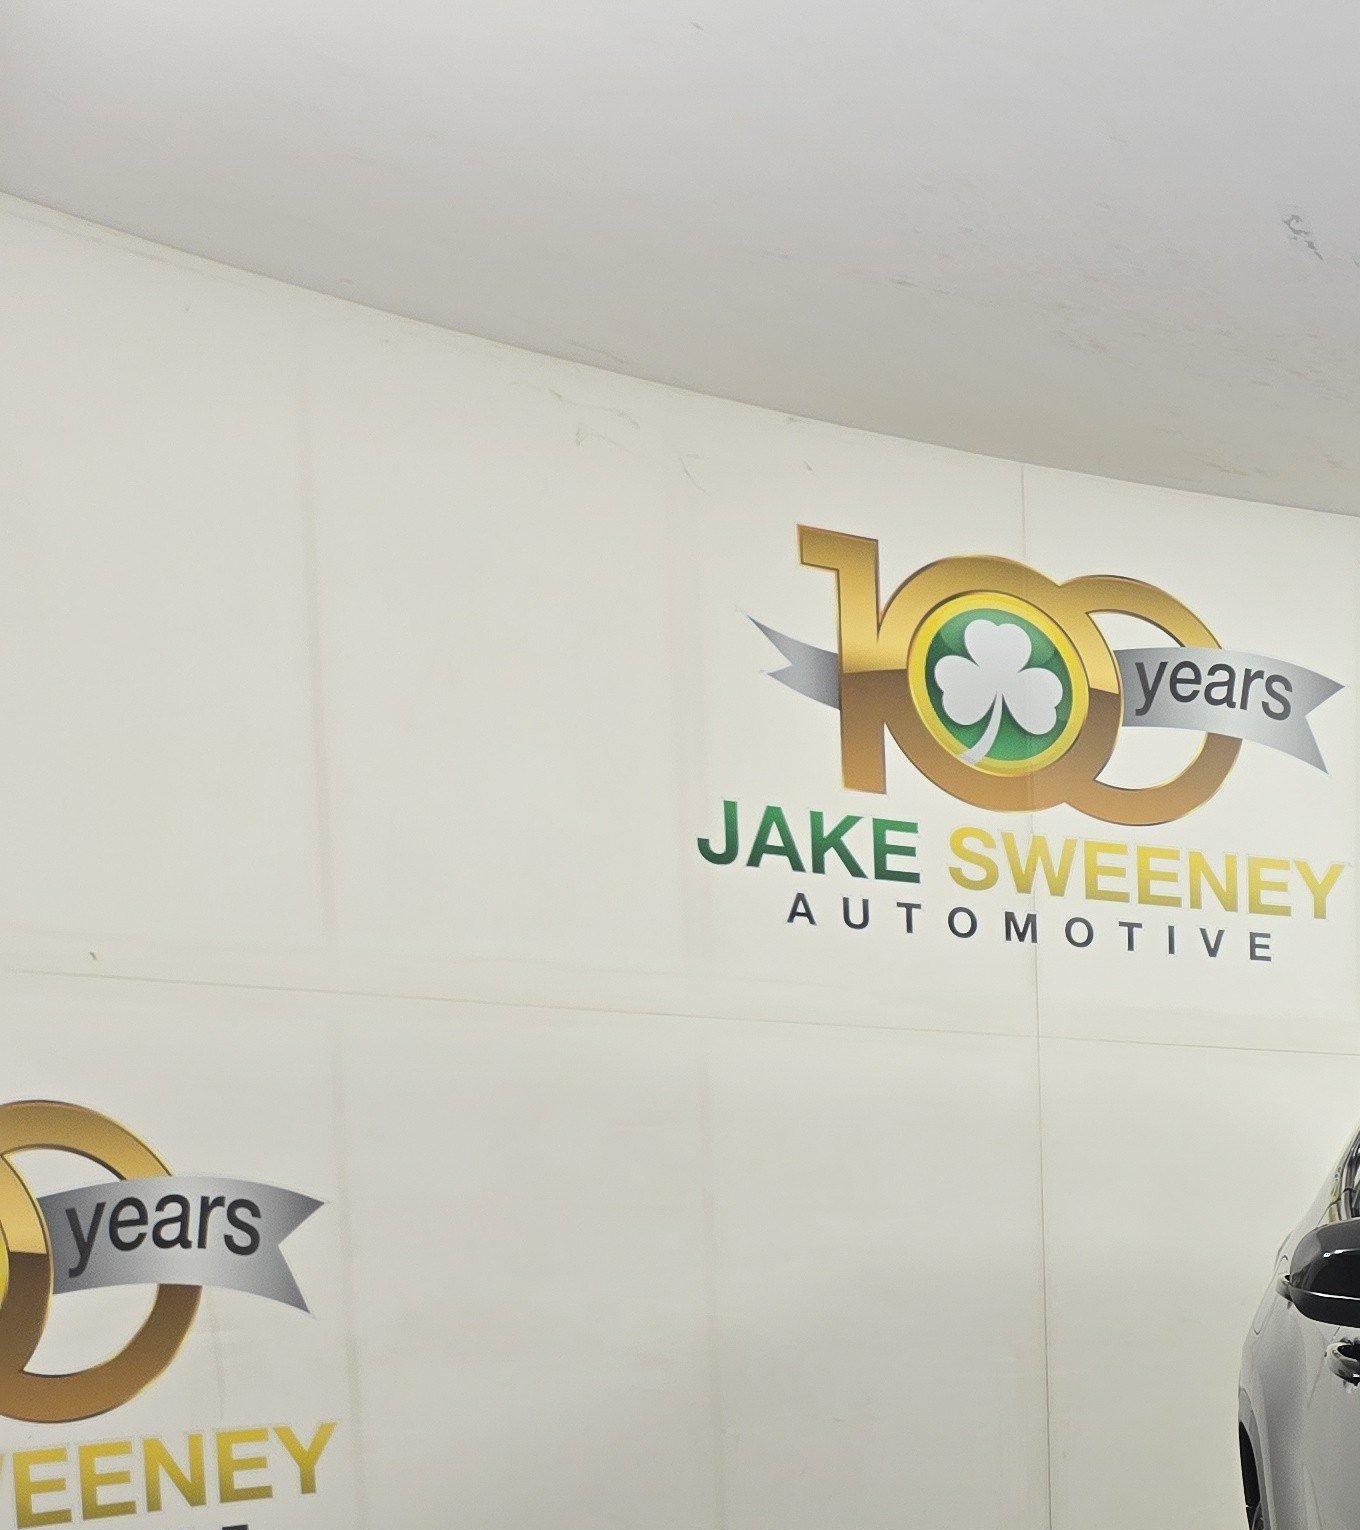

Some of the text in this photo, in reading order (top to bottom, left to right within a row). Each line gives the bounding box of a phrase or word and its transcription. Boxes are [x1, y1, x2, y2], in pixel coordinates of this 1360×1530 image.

[1134, 659, 1294, 722] years
[697, 799, 1346, 920] JAKE SWEENEY
[786, 892, 1273, 963] AUTOMOTIVE
[65, 1193, 262, 1279] years
[0, 1421, 337, 1530] EENEY
